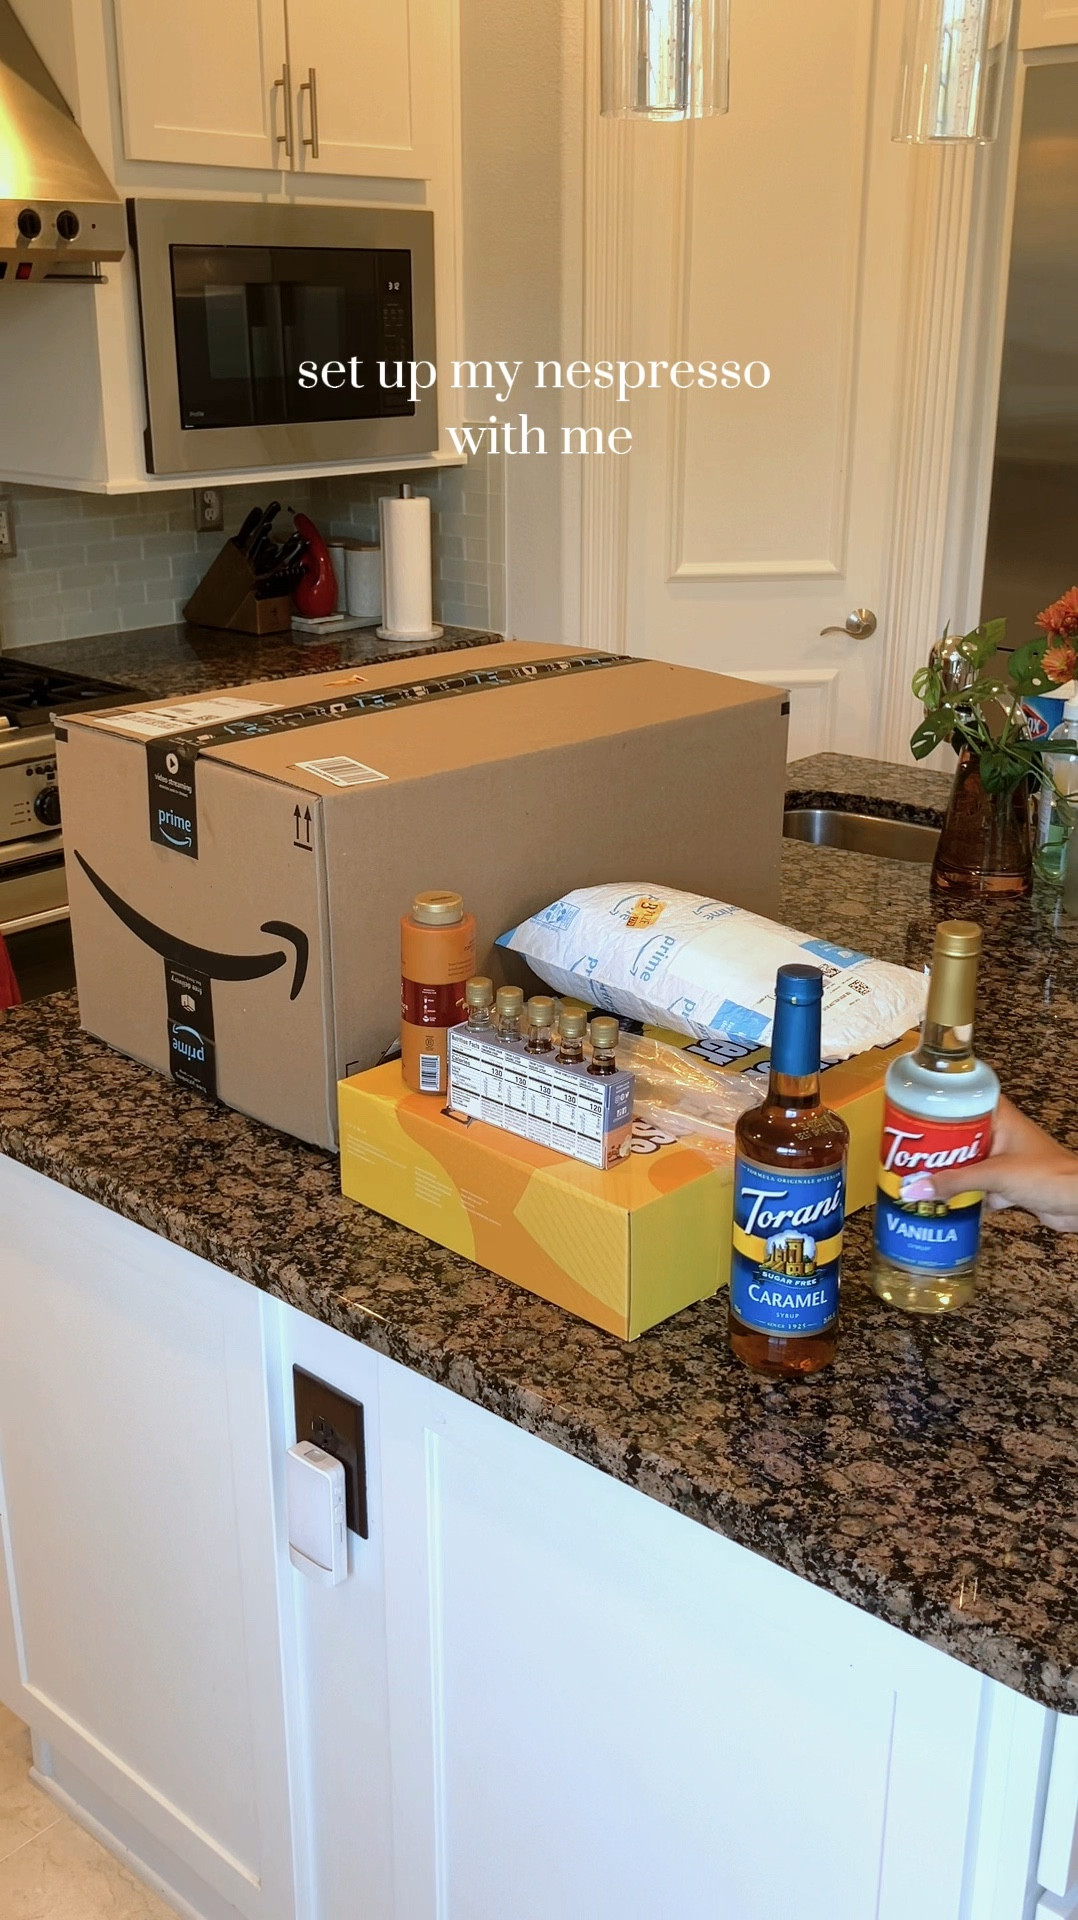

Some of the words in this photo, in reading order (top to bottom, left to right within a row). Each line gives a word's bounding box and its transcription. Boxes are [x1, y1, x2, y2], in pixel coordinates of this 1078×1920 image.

[158, 809, 192, 833] prime
[640, 935, 676, 982] prime
[172, 1037, 205, 1062] prime
[469, 1041, 480, 1050] Facts
[451, 1055, 471, 1066] Calories
[491, 1068, 503, 1077] 130
[515, 1077, 527, 1086] 130
[539, 1085, 551, 1095] 130
[564, 1094, 576, 1104] 130
[589, 1103, 602, 1113] 120
[884, 1126, 984, 1171] Torani
[747, 1168, 775, 1182] FORMULA
[777, 1177, 815, 1185] ORIGINALE
[741, 1181, 842, 1235] Torani
[886, 1213, 958, 1243] VANILLA
[762, 1271, 793, 1285] SUGAR
[794, 1278, 817, 1287] FREE
[748, 1284, 828, 1309] CARAMEL
[788, 1322, 806, 1330] 1925
